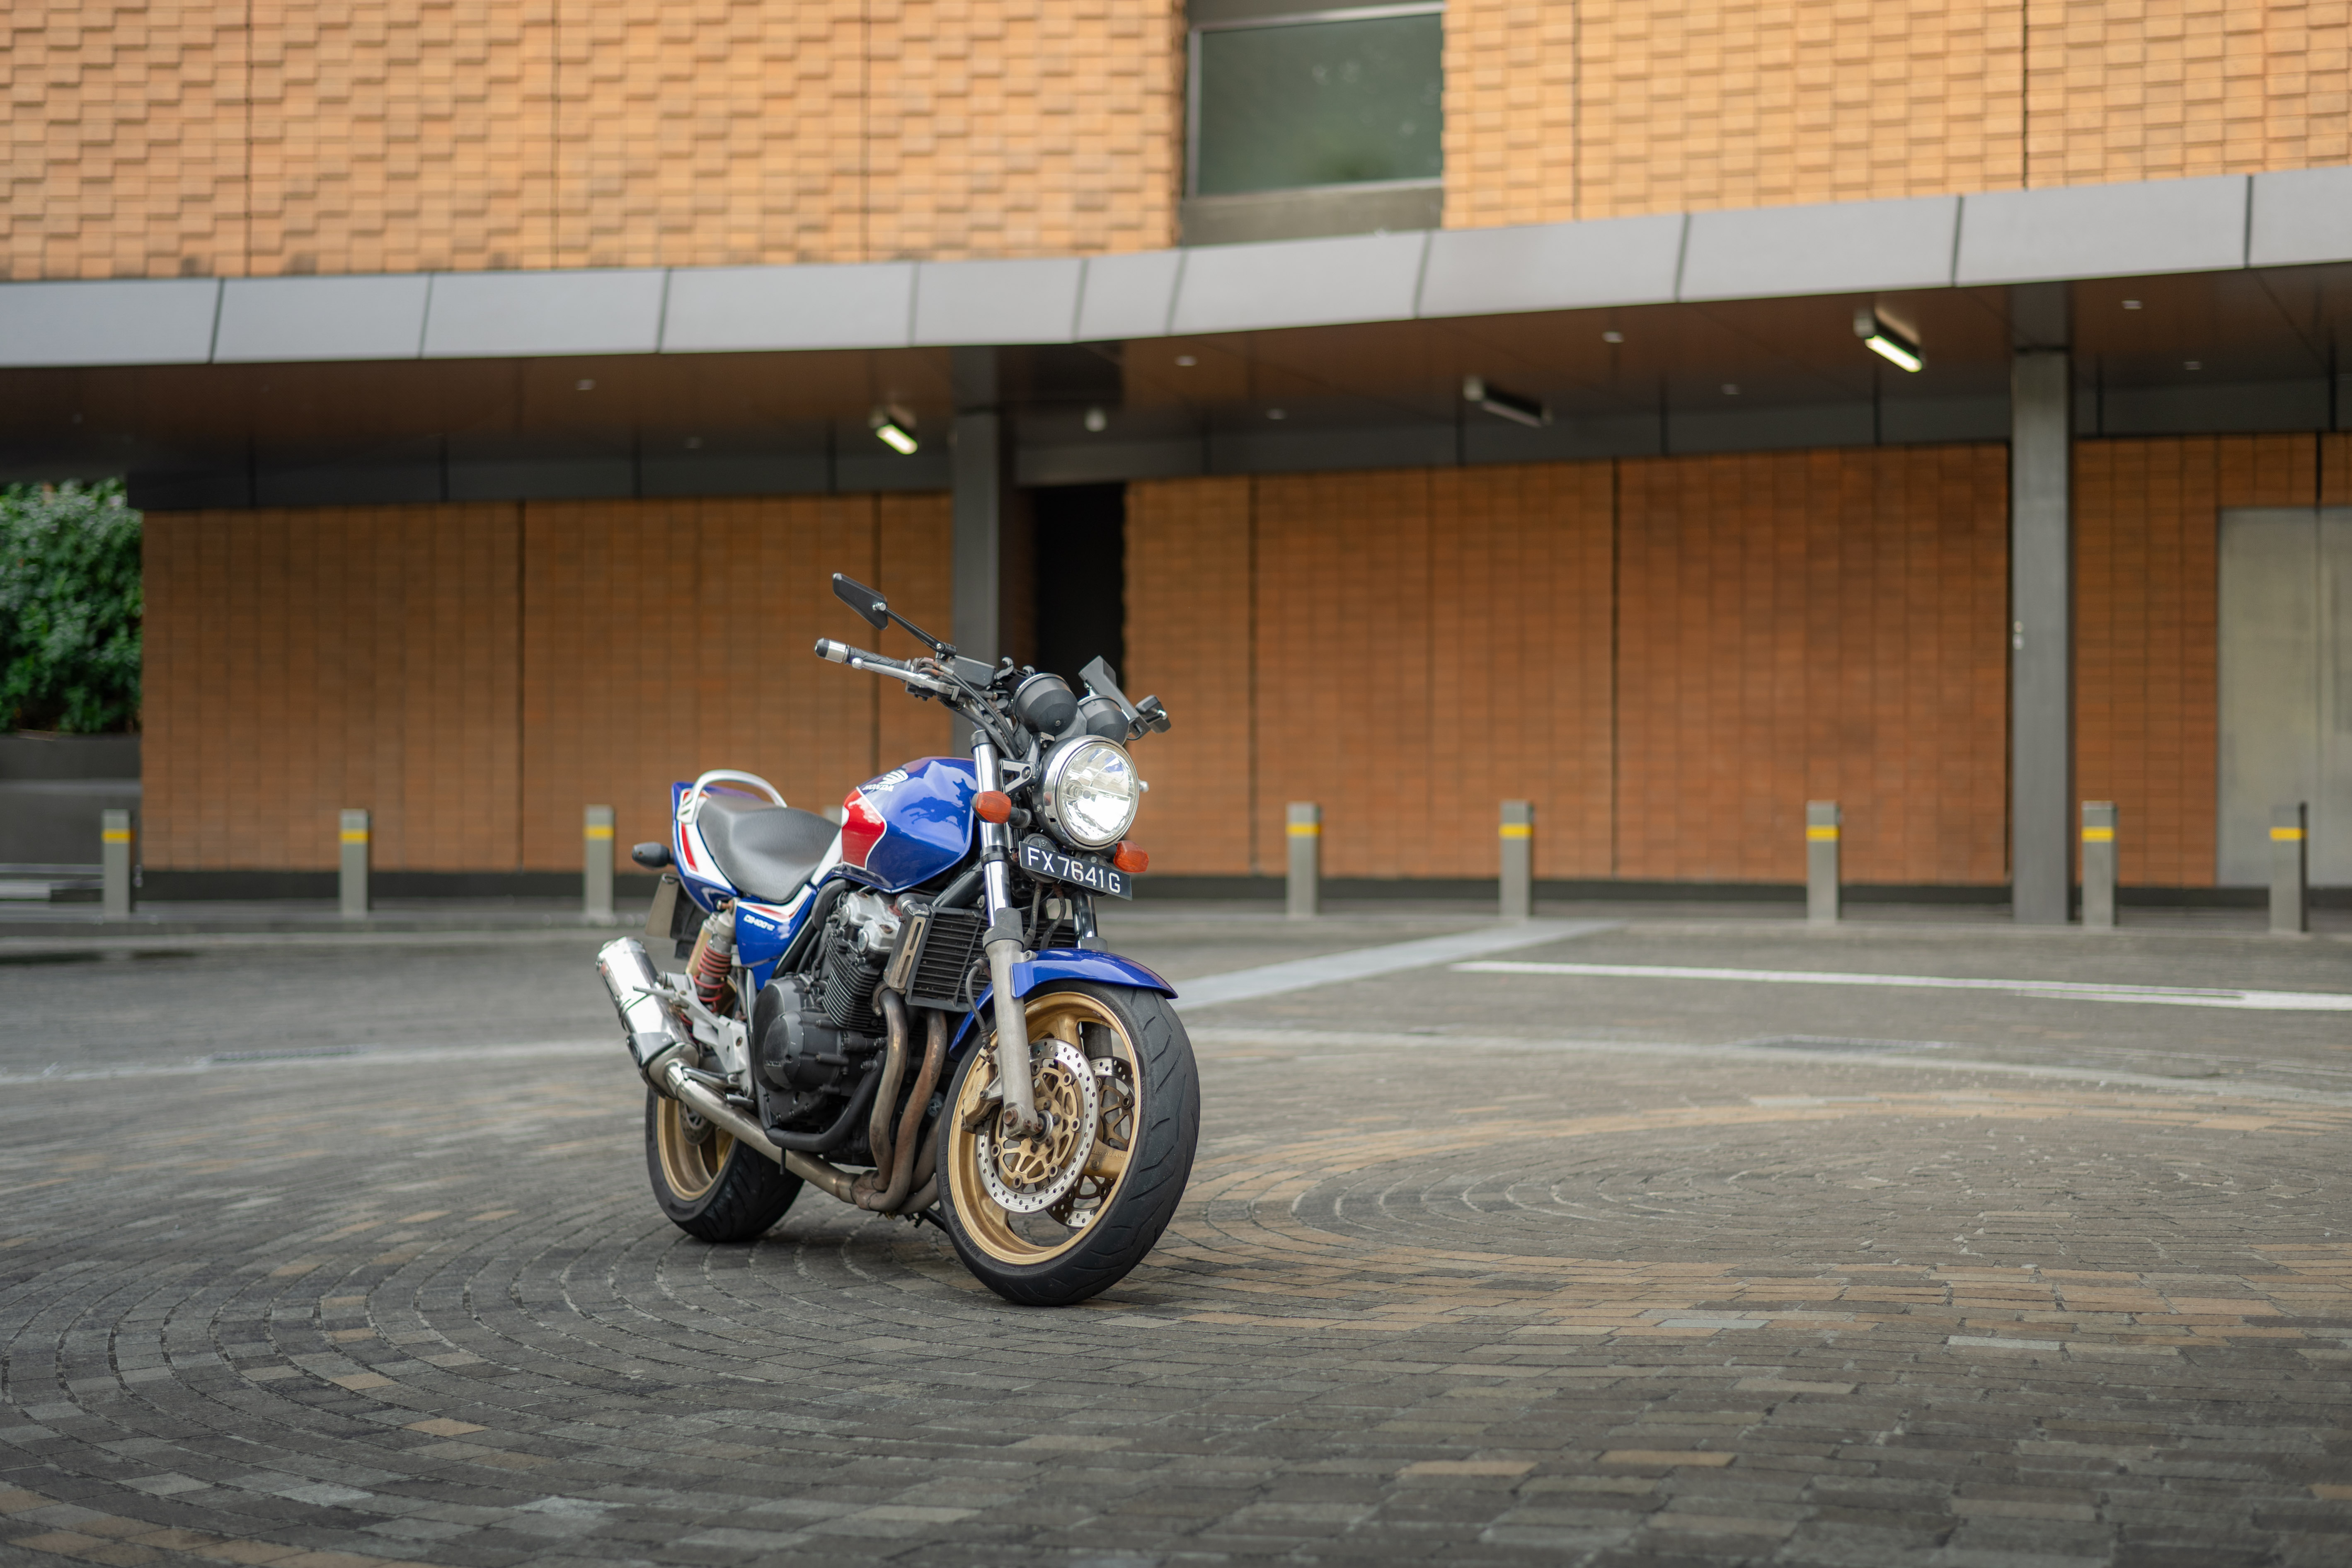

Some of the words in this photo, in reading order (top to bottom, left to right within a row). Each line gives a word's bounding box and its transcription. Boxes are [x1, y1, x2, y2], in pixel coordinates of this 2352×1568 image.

[862, 783, 894, 792] HONDA
[941, 1145, 950, 1195] ROSSO
[951, 1214, 981, 1258] DIABLO
